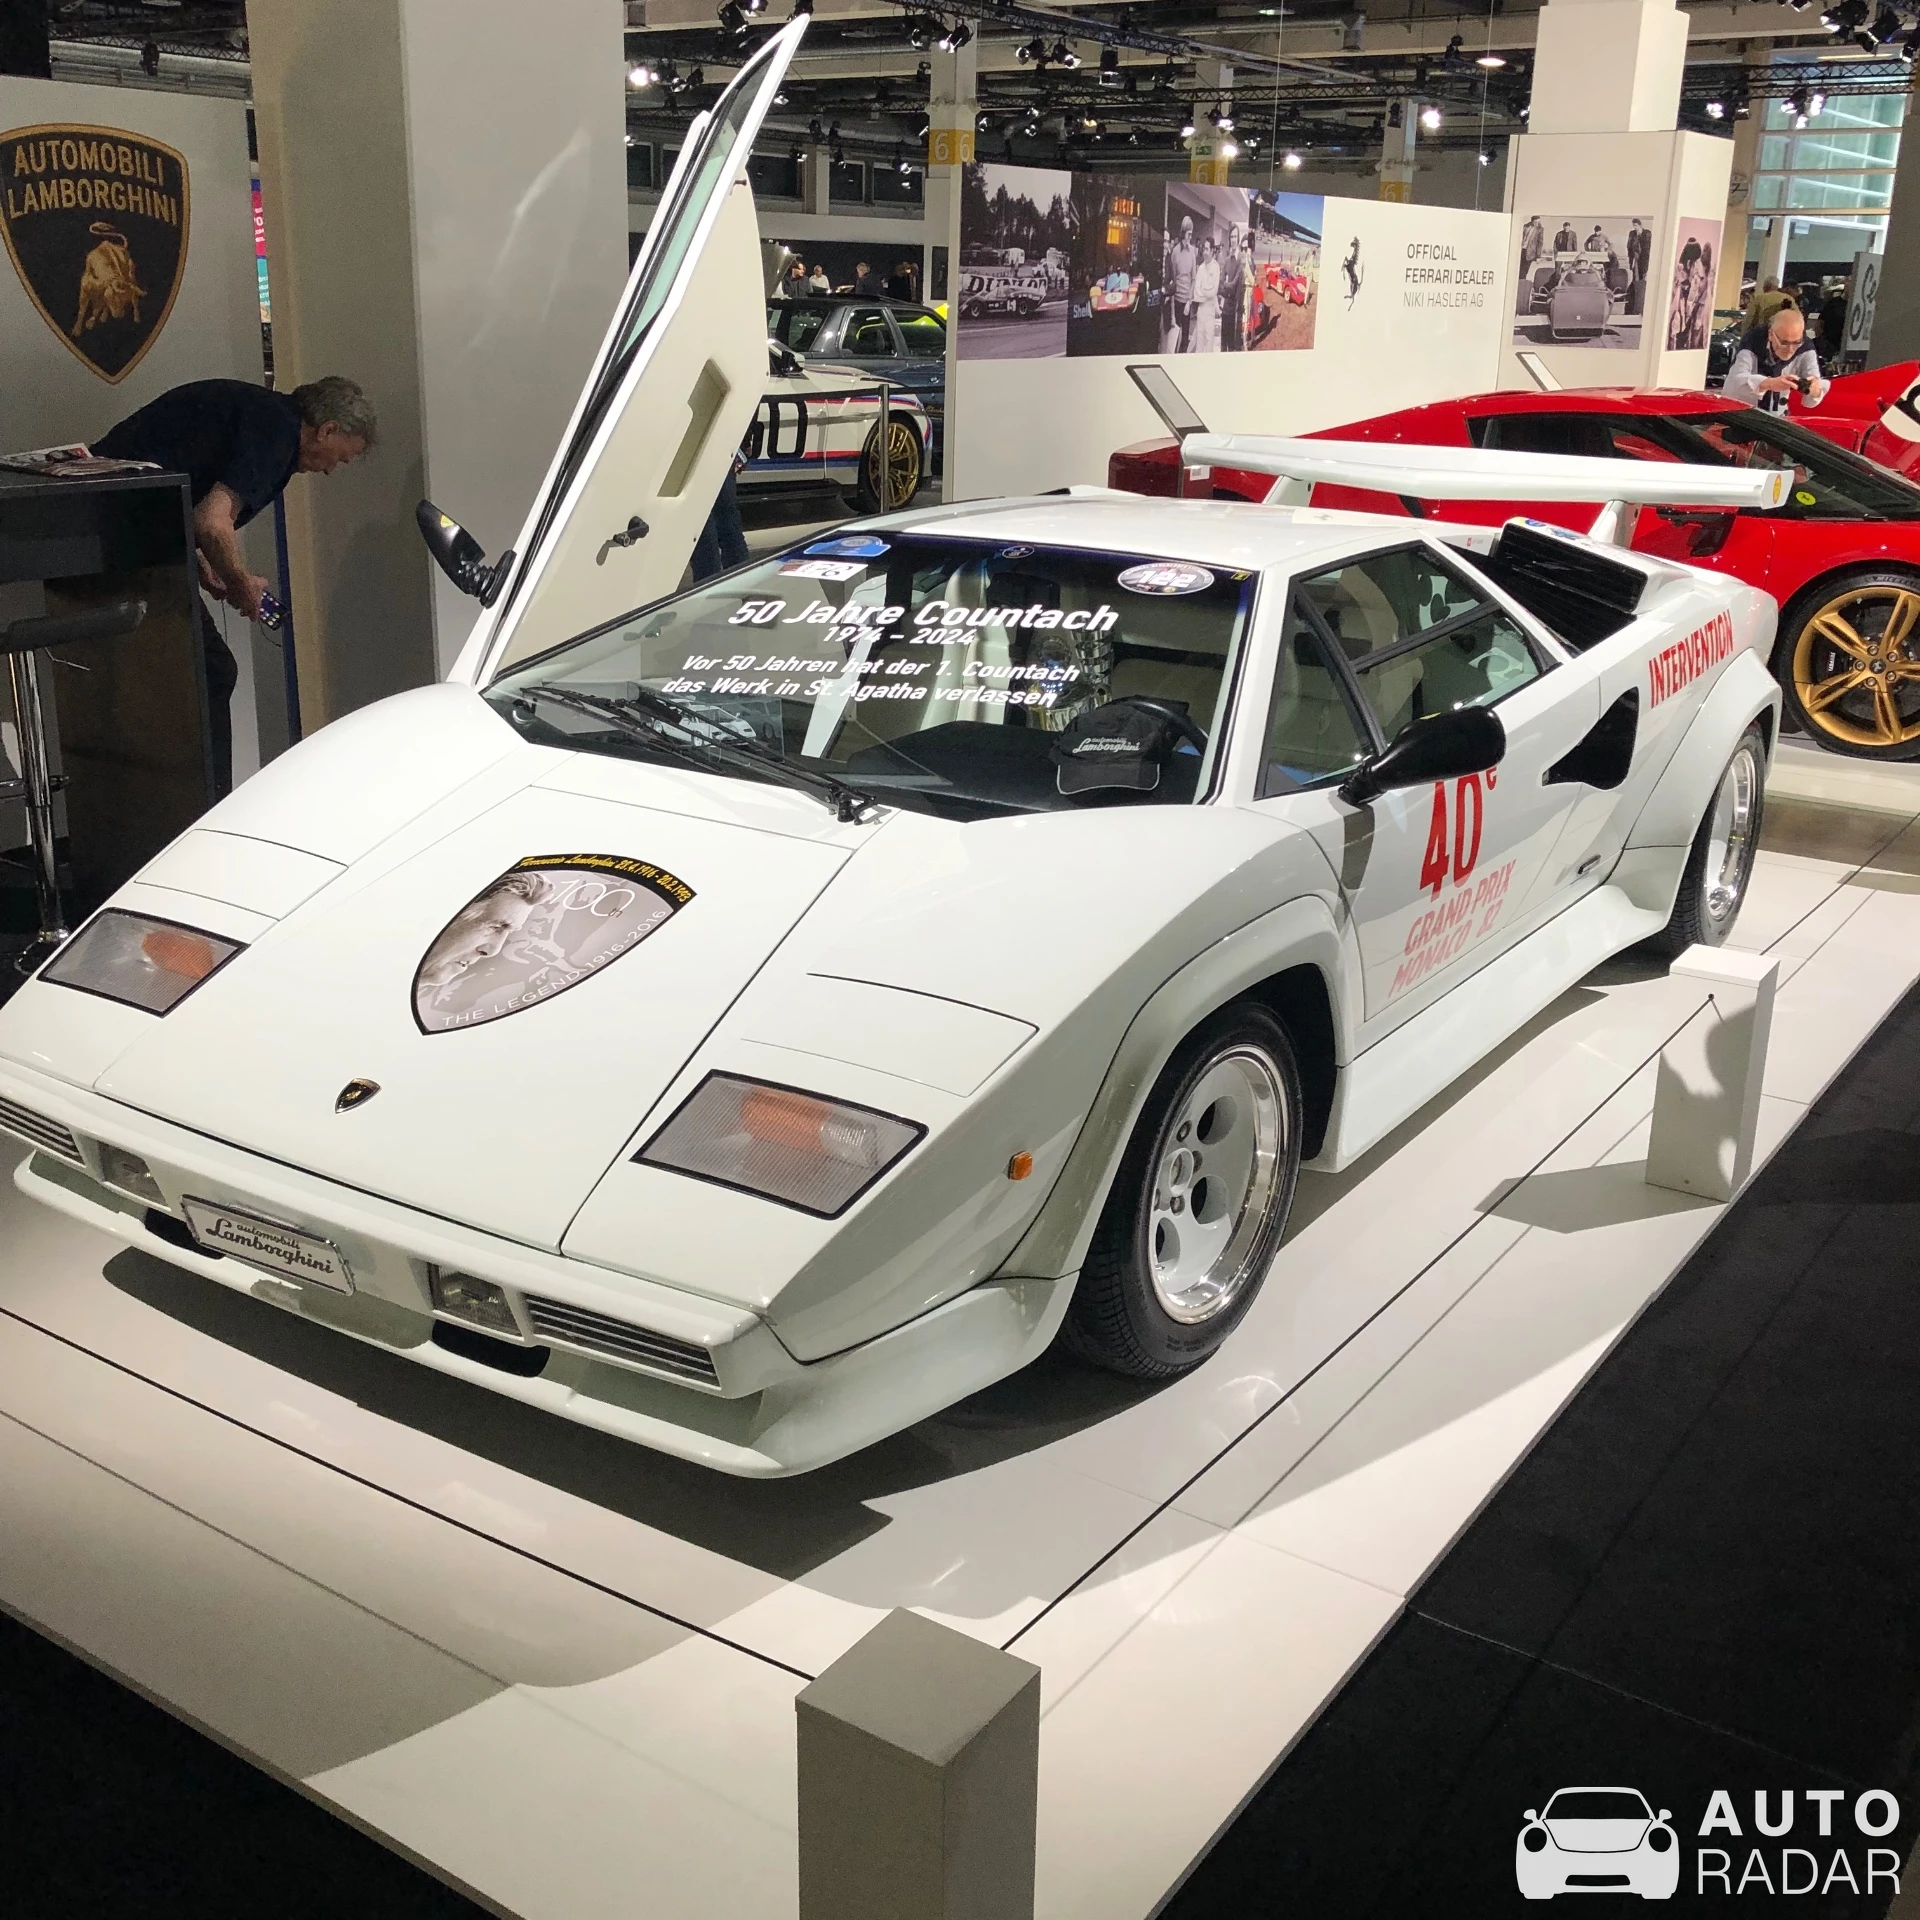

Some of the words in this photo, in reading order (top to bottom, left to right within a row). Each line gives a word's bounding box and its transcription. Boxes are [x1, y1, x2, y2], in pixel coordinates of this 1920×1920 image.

[934, 132, 949, 161] 6
[960, 133, 970, 162] 6
[14, 139, 164, 187] AUTOMOBILI
[8, 178, 178, 226] LAMBORGHINI
[1407, 243, 1457, 261] OFFICIAL
[1405, 267, 1453, 284] FERRARI
[1455, 269, 1494, 285] DEALER
[1403, 291, 1424, 307] NIKI
[1427, 292, 1468, 308] HASLER
[1469, 292, 1484, 308] AG
[1138, 571, 1197, 588] 122
[727, 600, 787, 624] 50
[781, 600, 905, 625] Jahre
[913, 600, 1120, 631] Countach
[823, 626, 885, 643] 1974
[909, 628, 977, 645] 2024
[682, 655, 723, 671] Vor
[722, 655, 757, 671] 50
[754, 655, 839, 674] Jahren
[841, 658, 885, 675] hat
[885, 659, 931, 676] der
[935, 660, 953, 676] 1.
[962, 660, 1080, 682] Countach
[1648, 608, 1734, 709] INTERVENTION
[661, 677, 706, 694] das
[710, 678, 775, 695] Werk
[774, 678, 801, 696] in
[803, 678, 834, 697] St.
[840, 680, 928, 702] Agatha
[933, 686, 1058, 708] verlassen
[1072, 737, 1141, 754] Lamborghini
[1404, 887, 1472, 956] GRAND
[1471, 858, 1516, 914] PRIX
[1388, 919, 1473, 1000] MONACO
[1476, 899, 1504, 939] 82
[441, 1008, 485, 1027] THE
[494, 970, 580, 1013] LEGEND
[586, 909, 667, 970] 1916-2016
[205, 1218, 334, 1274] Lamborghini
[237, 1224, 300, 1250] automobili
